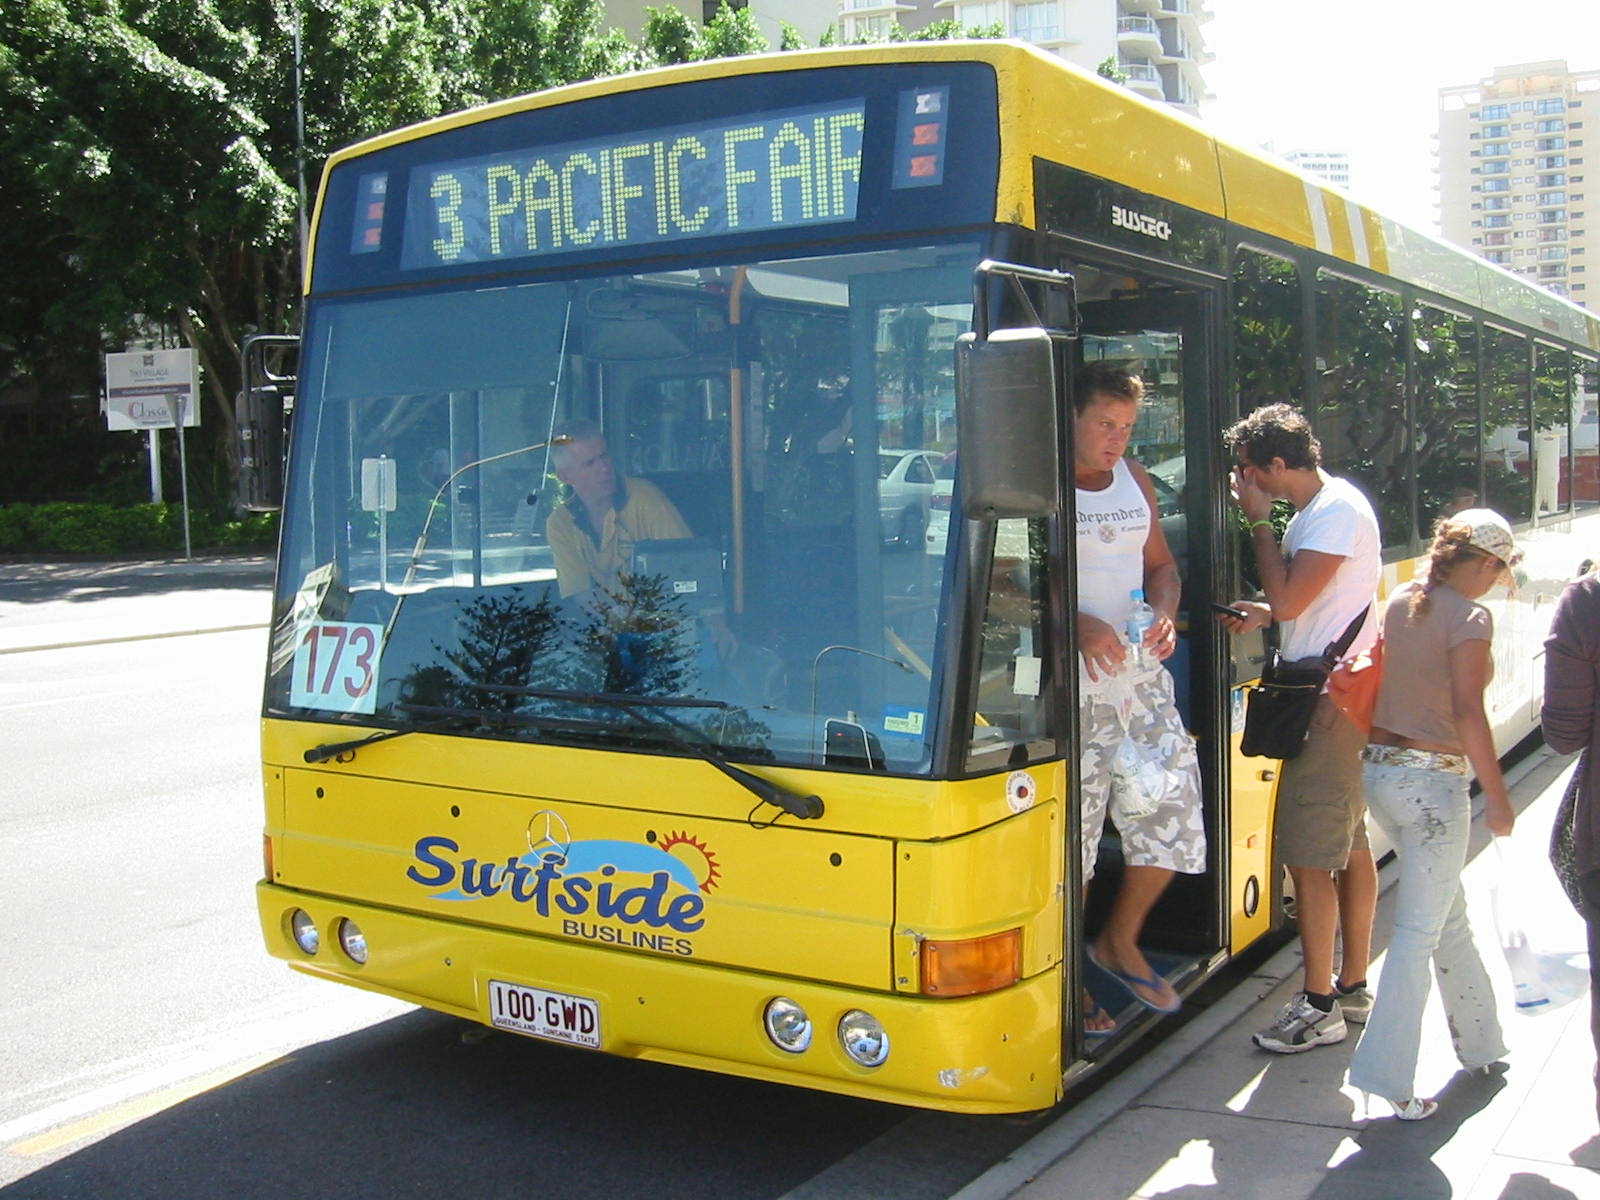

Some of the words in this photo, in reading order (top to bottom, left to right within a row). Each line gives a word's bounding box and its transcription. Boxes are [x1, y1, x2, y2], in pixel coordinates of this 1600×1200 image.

[430, 173, 464, 260] 3
[487, 136, 709, 254] PACIFIC
[302, 625, 375, 698] 173
[406, 835, 705, 933] Surfside
[562, 919, 694, 956] BUSLINES
[495, 1017, 536, 1032] QUEENSLAND
[576, 1033, 596, 1045] STATE
